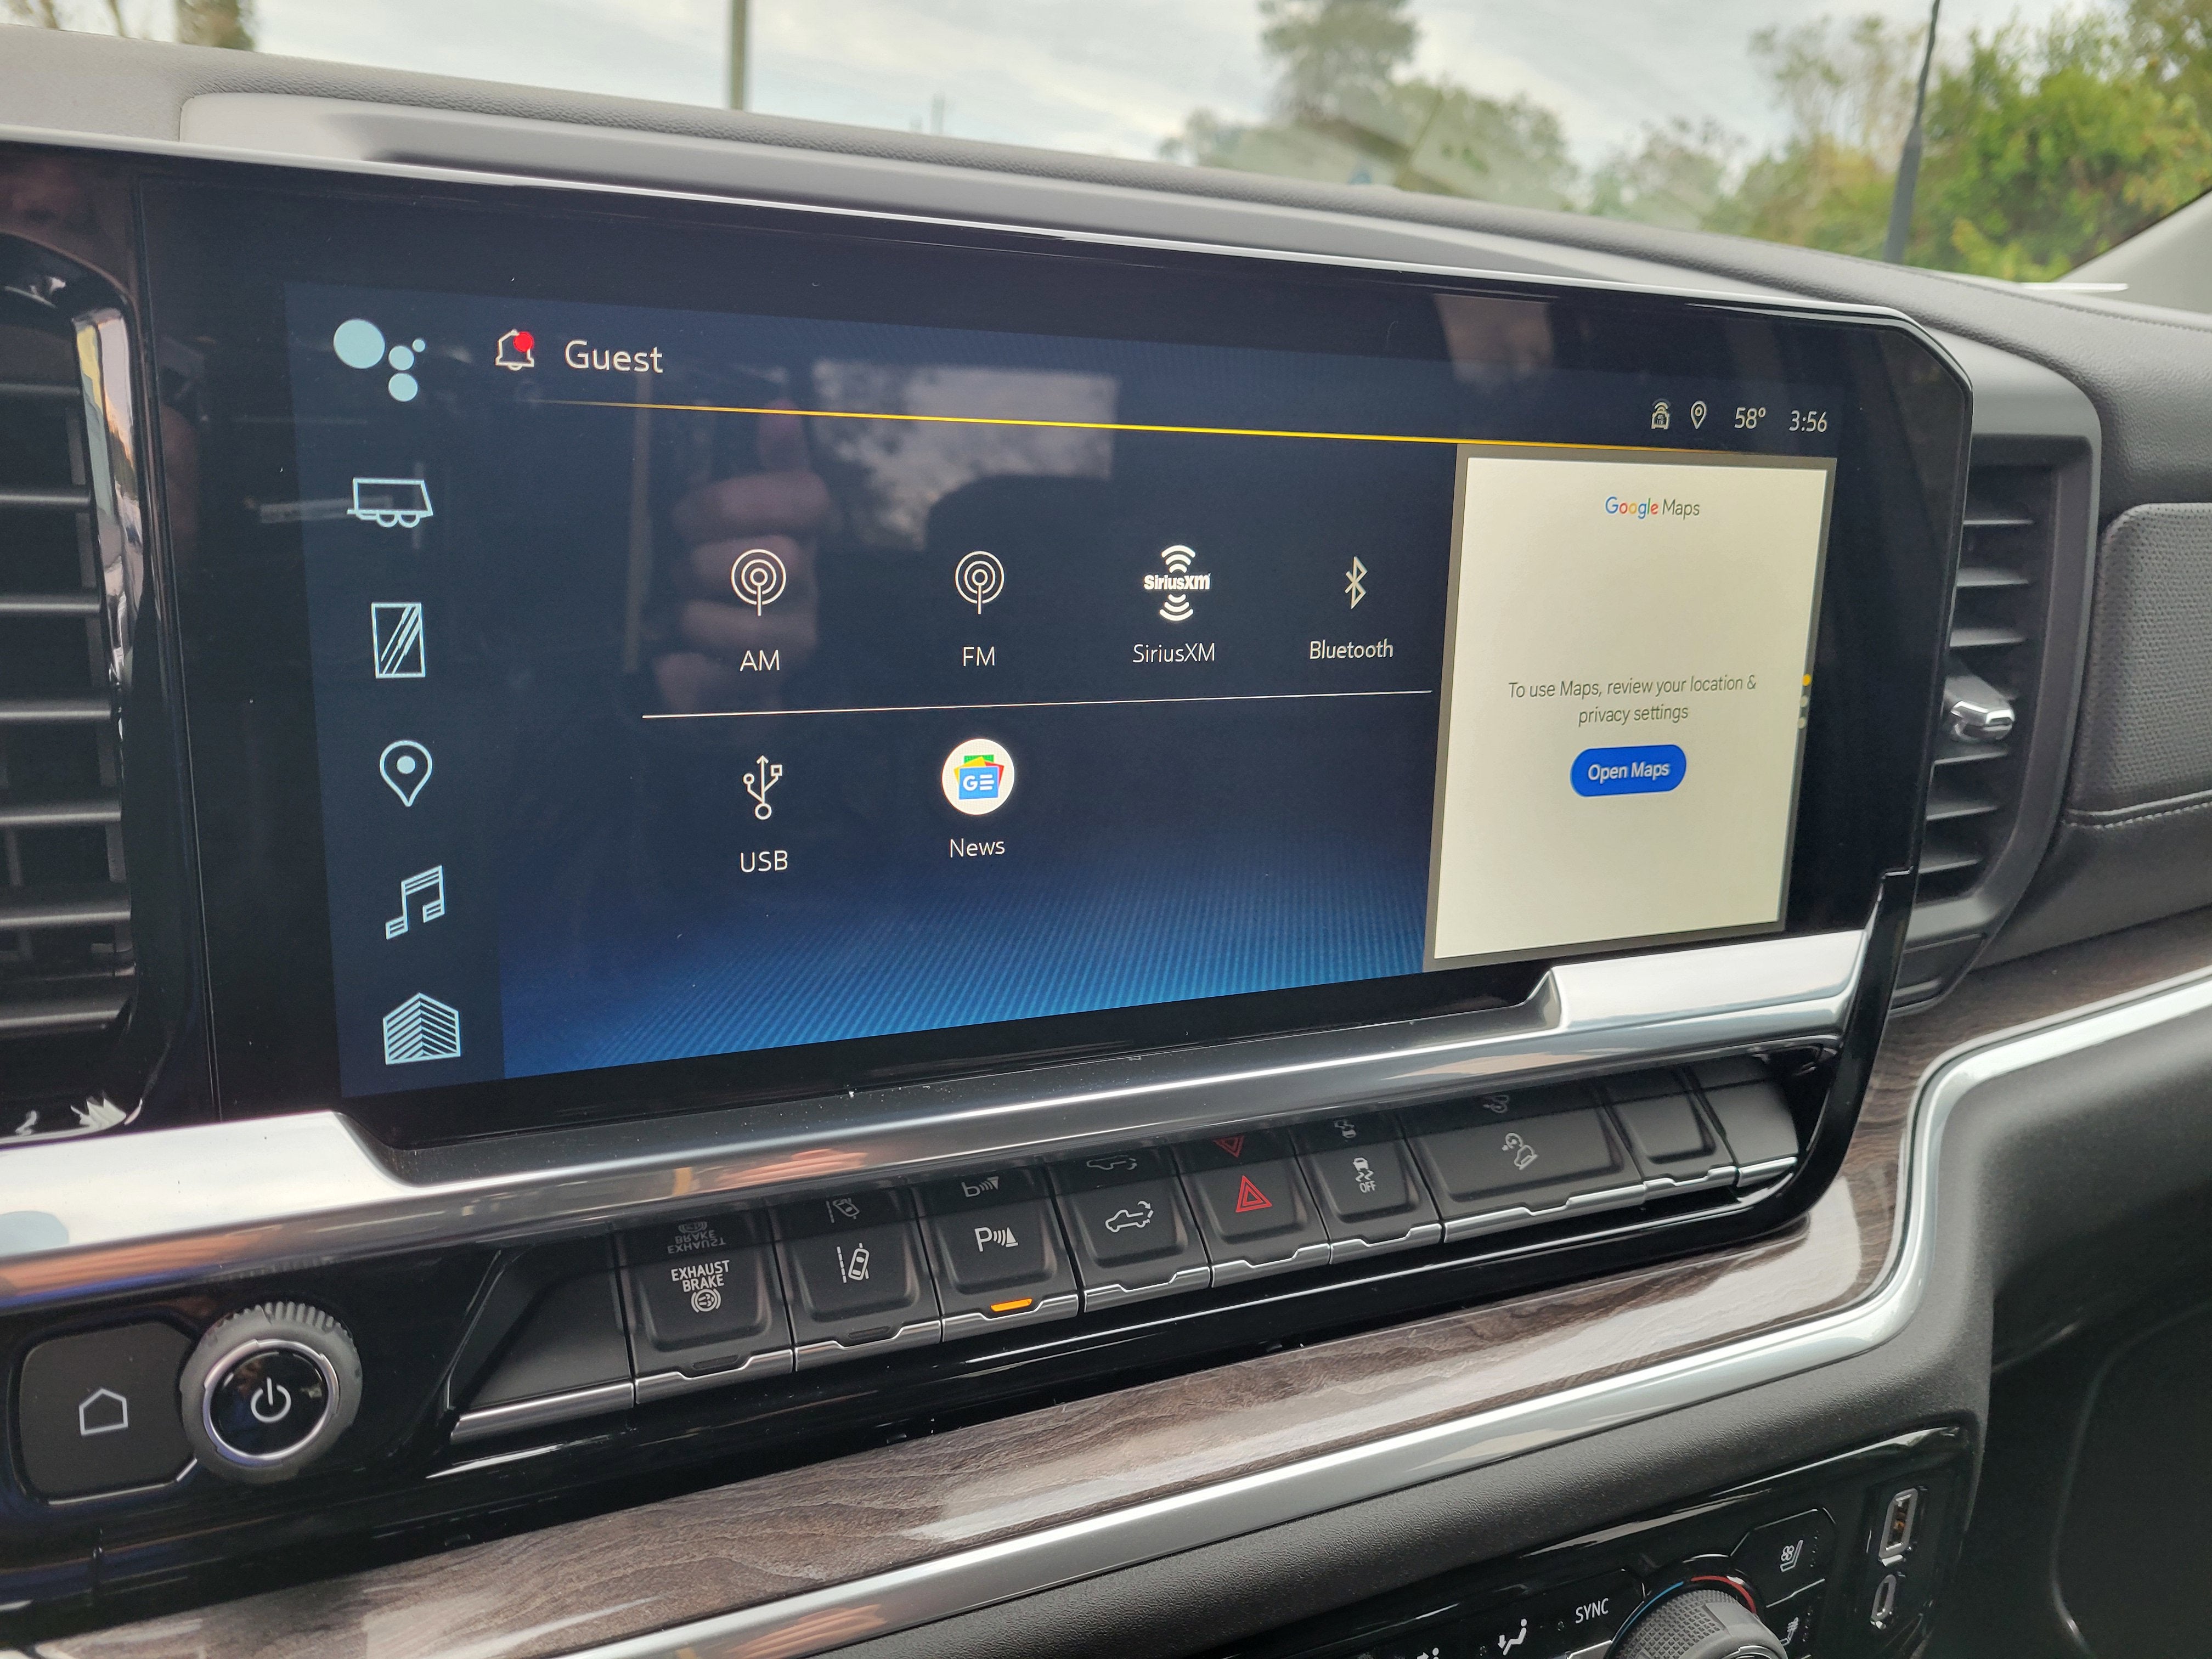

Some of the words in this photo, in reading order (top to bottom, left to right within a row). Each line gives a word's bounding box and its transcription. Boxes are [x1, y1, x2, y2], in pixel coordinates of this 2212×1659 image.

[565, 339, 663, 374] Guest
[1734, 407, 1767, 430] 58°
[1788, 409, 1828, 433] 3:56
[1605, 496, 1659, 520] Google
[1662, 498, 1700, 521] Maps
[740, 649, 780, 672] AM
[962, 646, 996, 667] FM
[1132, 642, 1216, 663] SiriusXM
[1309, 638, 1393, 660] Bluetooth
[1508, 682, 1525, 698] To
[1529, 684, 1555, 697] use
[1560, 680, 1602, 700] Maps,
[1607, 678, 1655, 695] review
[1656, 679, 1687, 697] your
[1690, 675, 1743, 692] location
[1746, 674, 1757, 690] &
[1578, 706, 1630, 727] privacy
[1633, 704, 1689, 724] settings
[1587, 764, 1627, 784] Open
[1630, 760, 1671, 782] Maps
[949, 838, 1005, 858] News
[740, 850, 788, 873] USB
[1359, 1180, 1377, 1193] OFF
[671, 1260, 730, 1282] EXHAUST
[682, 1273, 725, 1293] BRAKE
[1575, 1598, 1610, 1624] SYNC
